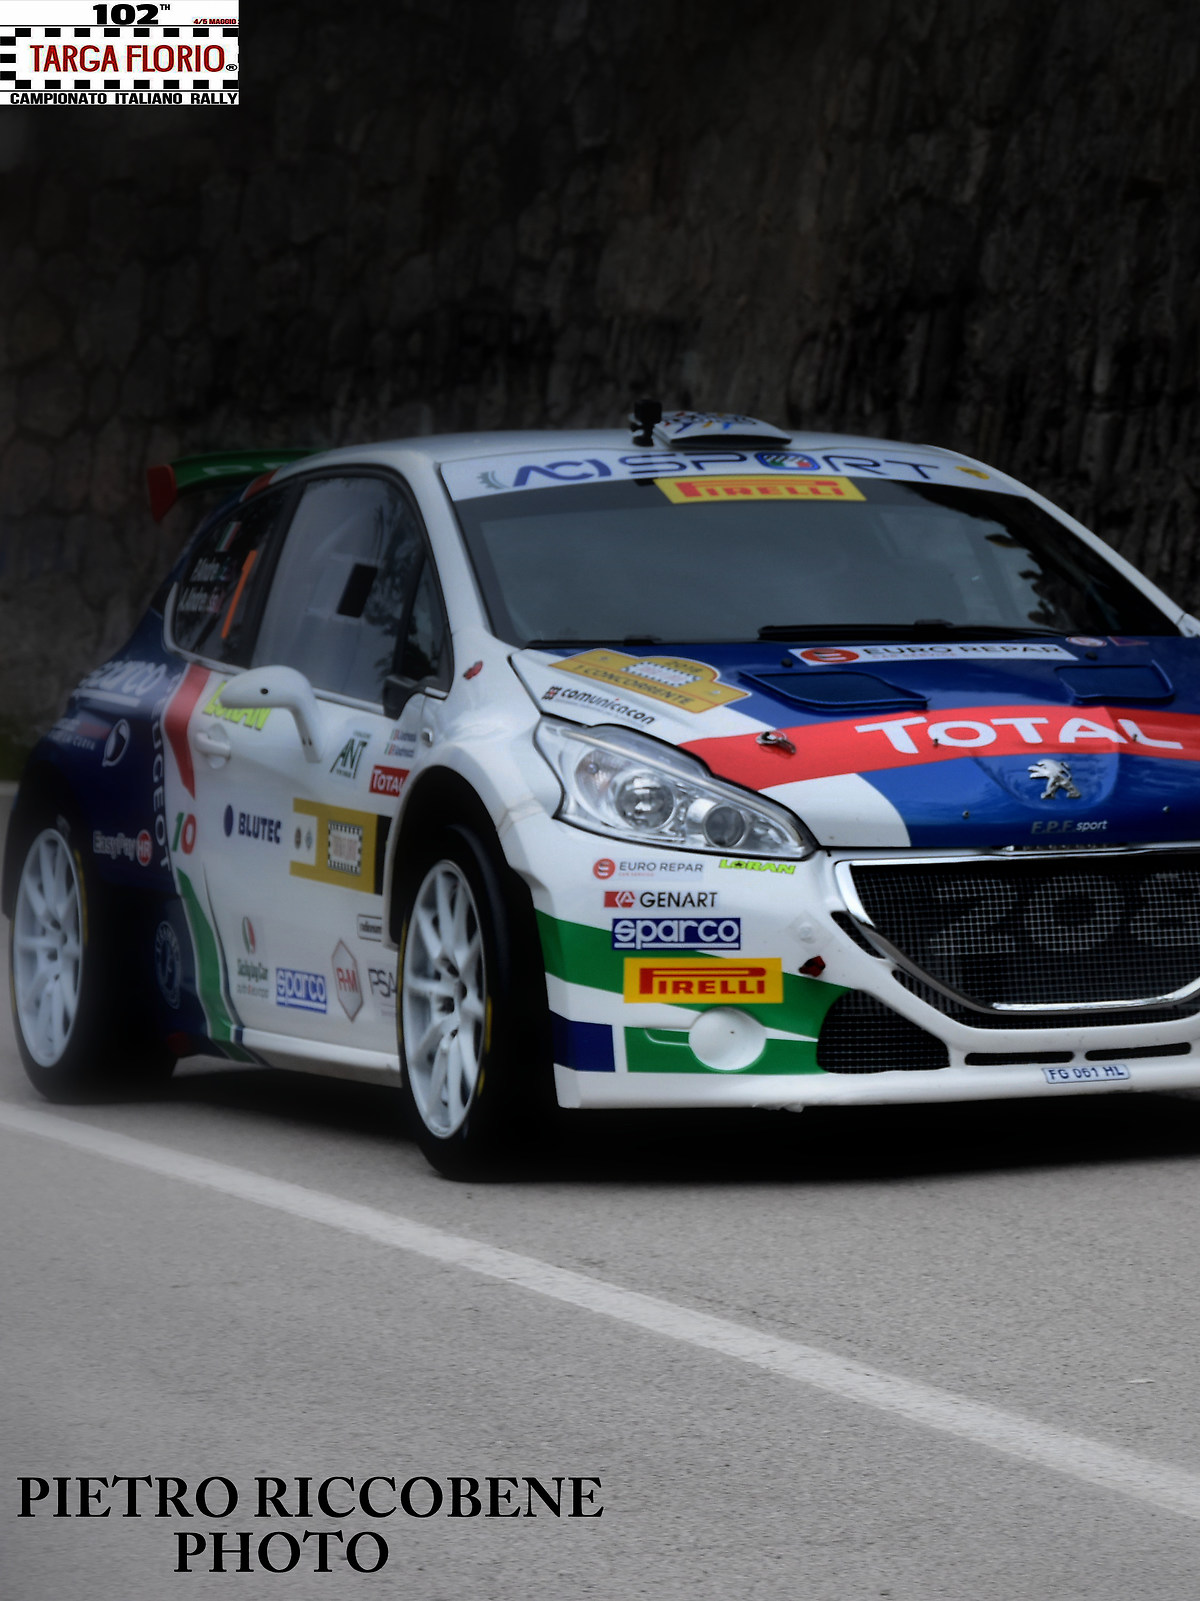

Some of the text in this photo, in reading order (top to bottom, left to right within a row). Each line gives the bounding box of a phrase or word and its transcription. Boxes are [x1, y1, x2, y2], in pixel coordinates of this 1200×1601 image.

[674, 480, 845, 497] PIRELLI
[863, 646, 1064, 655] EURO REPAR
[561, 688, 656, 725] comunicacon
[855, 716, 1183, 754] TOTAL
[171, 811, 197, 855] 10
[238, 812, 282, 845] BLUTEC
[1076, 820, 1108, 832] sport
[619, 861, 704, 873] EURO REPAR
[719, 859, 796, 875] LORAN
[639, 891, 718, 908] GENART
[614, 920, 740, 949] sparco
[276, 969, 327, 1004] sparco
[639, 967, 767, 995] PIRELLI
[1048, 1066, 1125, 1080] FG 061 HL
